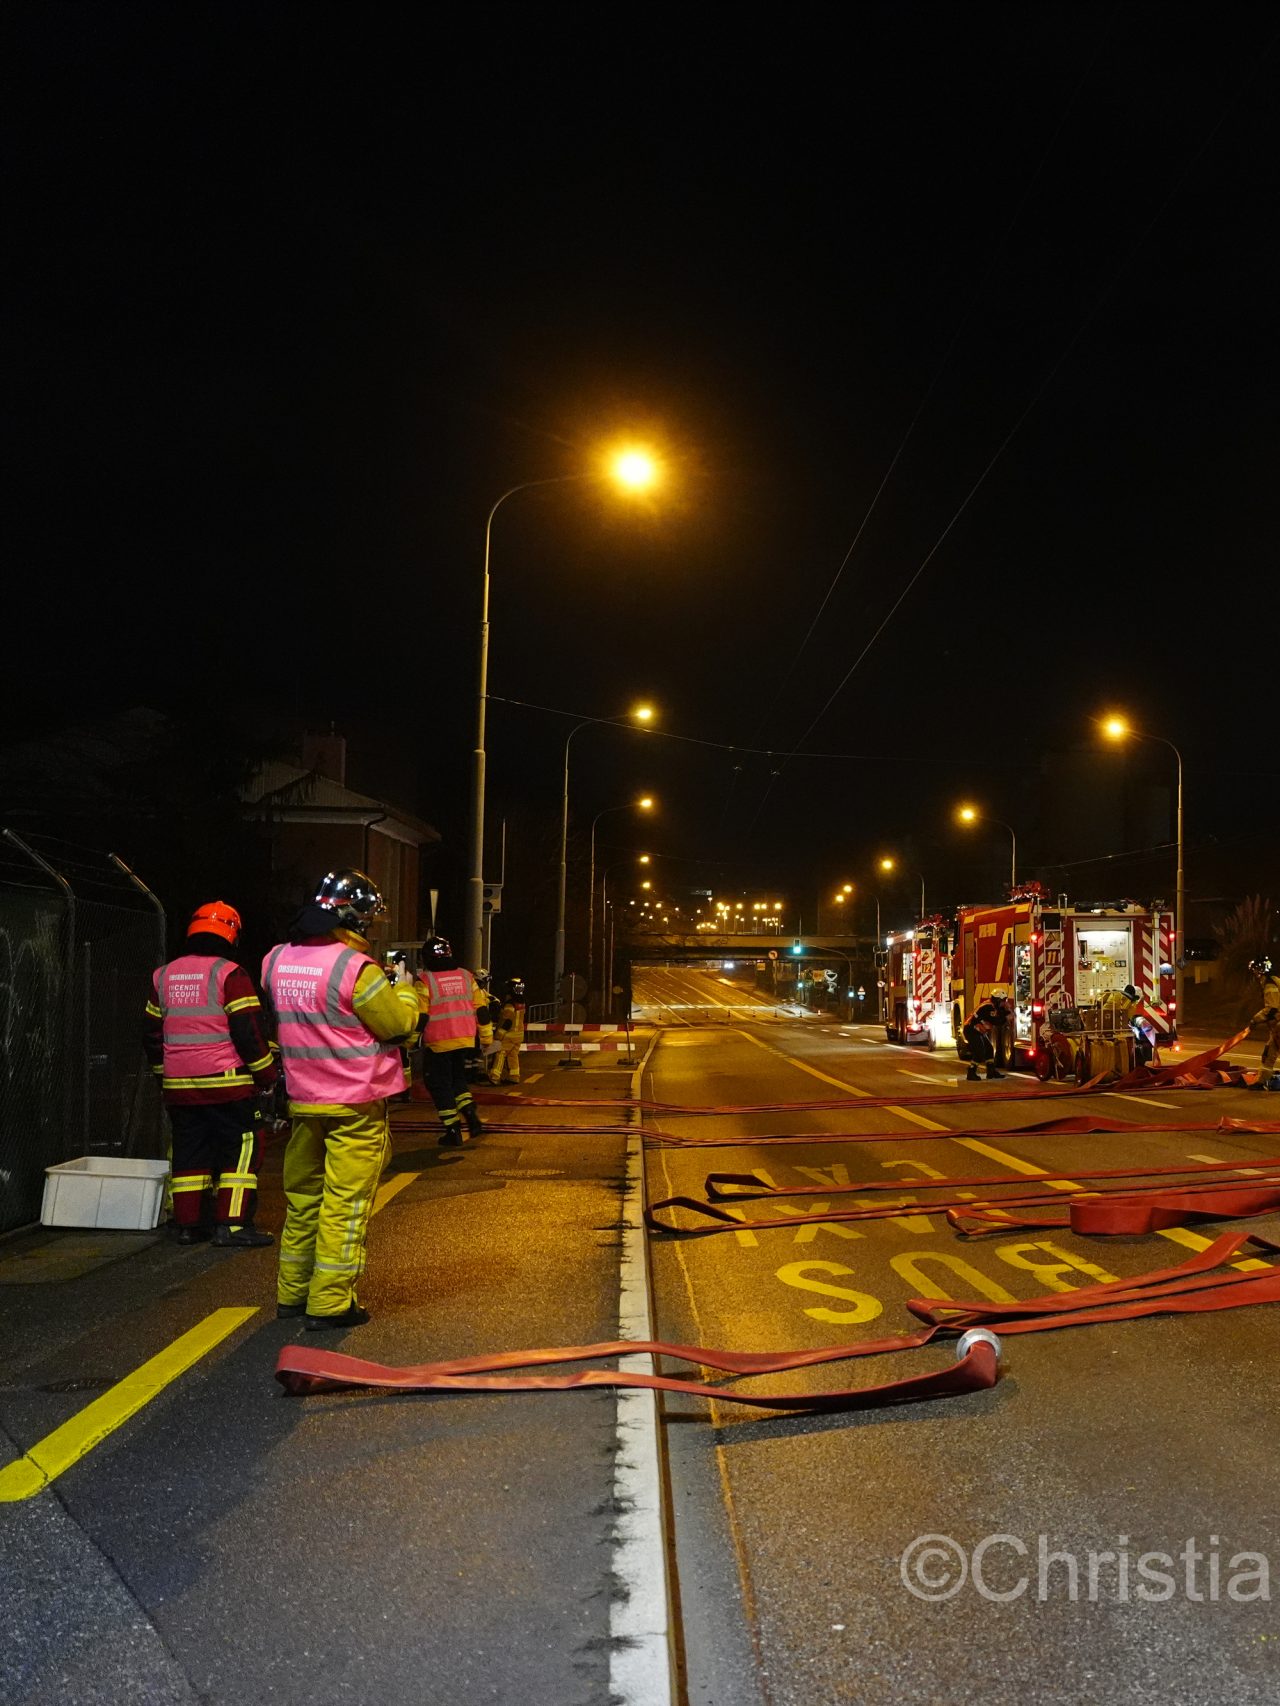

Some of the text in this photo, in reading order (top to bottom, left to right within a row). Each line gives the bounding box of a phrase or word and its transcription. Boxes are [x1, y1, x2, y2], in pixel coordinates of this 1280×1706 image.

[277, 964, 323, 977] OBSERVATEUR
[277, 978, 318, 990] INCENDIE
[276, 988, 317, 999] SECOURS
[775, 1240, 1121, 1324] BUS
